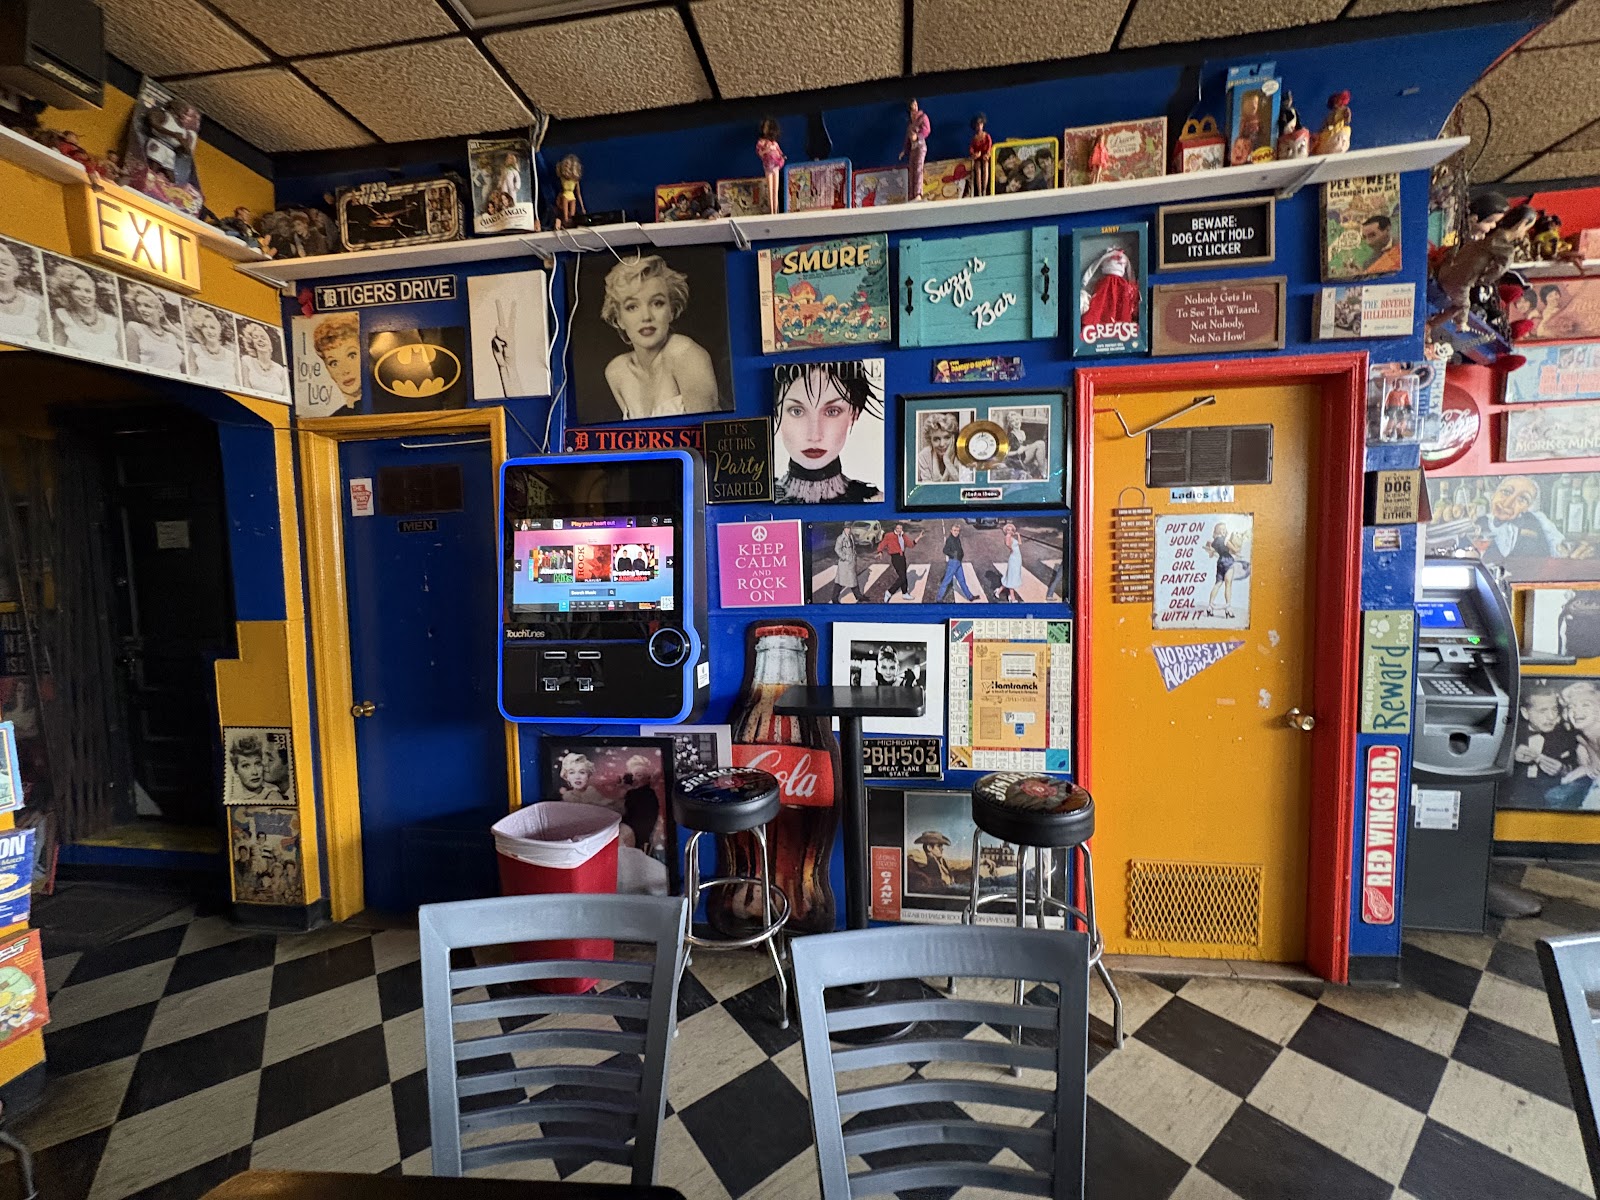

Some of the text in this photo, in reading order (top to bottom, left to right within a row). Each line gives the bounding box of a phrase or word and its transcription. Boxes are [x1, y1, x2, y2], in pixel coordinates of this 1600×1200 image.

[359, 181, 387, 194] STAR
[359, 192, 391, 205] WARS
[1192, 215, 1237, 230] BEWARE:
[97, 199, 191, 281] EXIT
[1172, 227, 1254, 245] DOG CAN'T HOLD
[1188, 242, 1241, 257] ITS LICKER
[783, 244, 872, 275] SMURF
[924, 256, 986, 308] Suzy's
[337, 282, 397, 306] TIGERS
[400, 277, 451, 299] DRIVE
[1184, 291, 1252, 305] Nobody Gets In
[1176, 302, 1260, 318] To See The Wizard,
[1363, 297, 1412, 310] THE BEVERLY
[971, 292, 1016, 330] Bar
[1363, 308, 1412, 320] HILLBILLIES
[1191, 317, 1244, 331] Not Nobody,
[1083, 322, 1138, 344] GREASE
[1189, 331, 1246, 344] Not No How!
[302, 331, 307, 356] I
[775, 360, 882, 384] COUTURE
[724, 422, 748, 436] LET'S
[595, 430, 674, 450] TIGERS
[718, 437, 756, 451] GET THIS
[1516, 439, 1556, 452] MORK
[710, 451, 765, 482] Party
[714, 481, 763, 498] STARTED
[1384, 481, 1411, 493] DOG
[1172, 489, 1209, 500] Ladies
[1383, 512, 1412, 520] EITHER
[403, 520, 434, 532] MEN
[1165, 522, 1205, 534] PUT ON
[1169, 535, 1200, 546] YOUR
[738, 543, 784, 556] KEEP
[1174, 548, 1193, 559] BIG
[577, 547, 585, 577] ROCK
[735, 556, 787, 569] CALM
[1172, 561, 1196, 572] GIRL
[738, 577, 787, 590] ROCK
[1160, 573, 1207, 584] PANTIES
[750, 590, 775, 602] ON
[1171, 586, 1195, 596] AND
[1168, 598, 1195, 609] DEAL
[1161, 610, 1204, 622] WITH IT
[506, 629, 546, 638] TouchTunes
[1155, 644, 1209, 668] NO BOYS
[1165, 643, 1228, 689] Allowed!
[991, 681, 1038, 690] Hamtramck
[1371, 644, 1410, 731] Reward
[273, 735, 286, 745] 33
[745, 750, 818, 798] Cola
[681, 772, 710, 793] JIM
[1366, 750, 1398, 887] RED WINGS RD.
[2, 856, 26, 865] Match
[0, 864, 17, 872] ame
[879, 870, 894, 906] GIANT
[927, 913, 947, 921] TAYLOR
[986, 916, 1004, 924] JAMES
